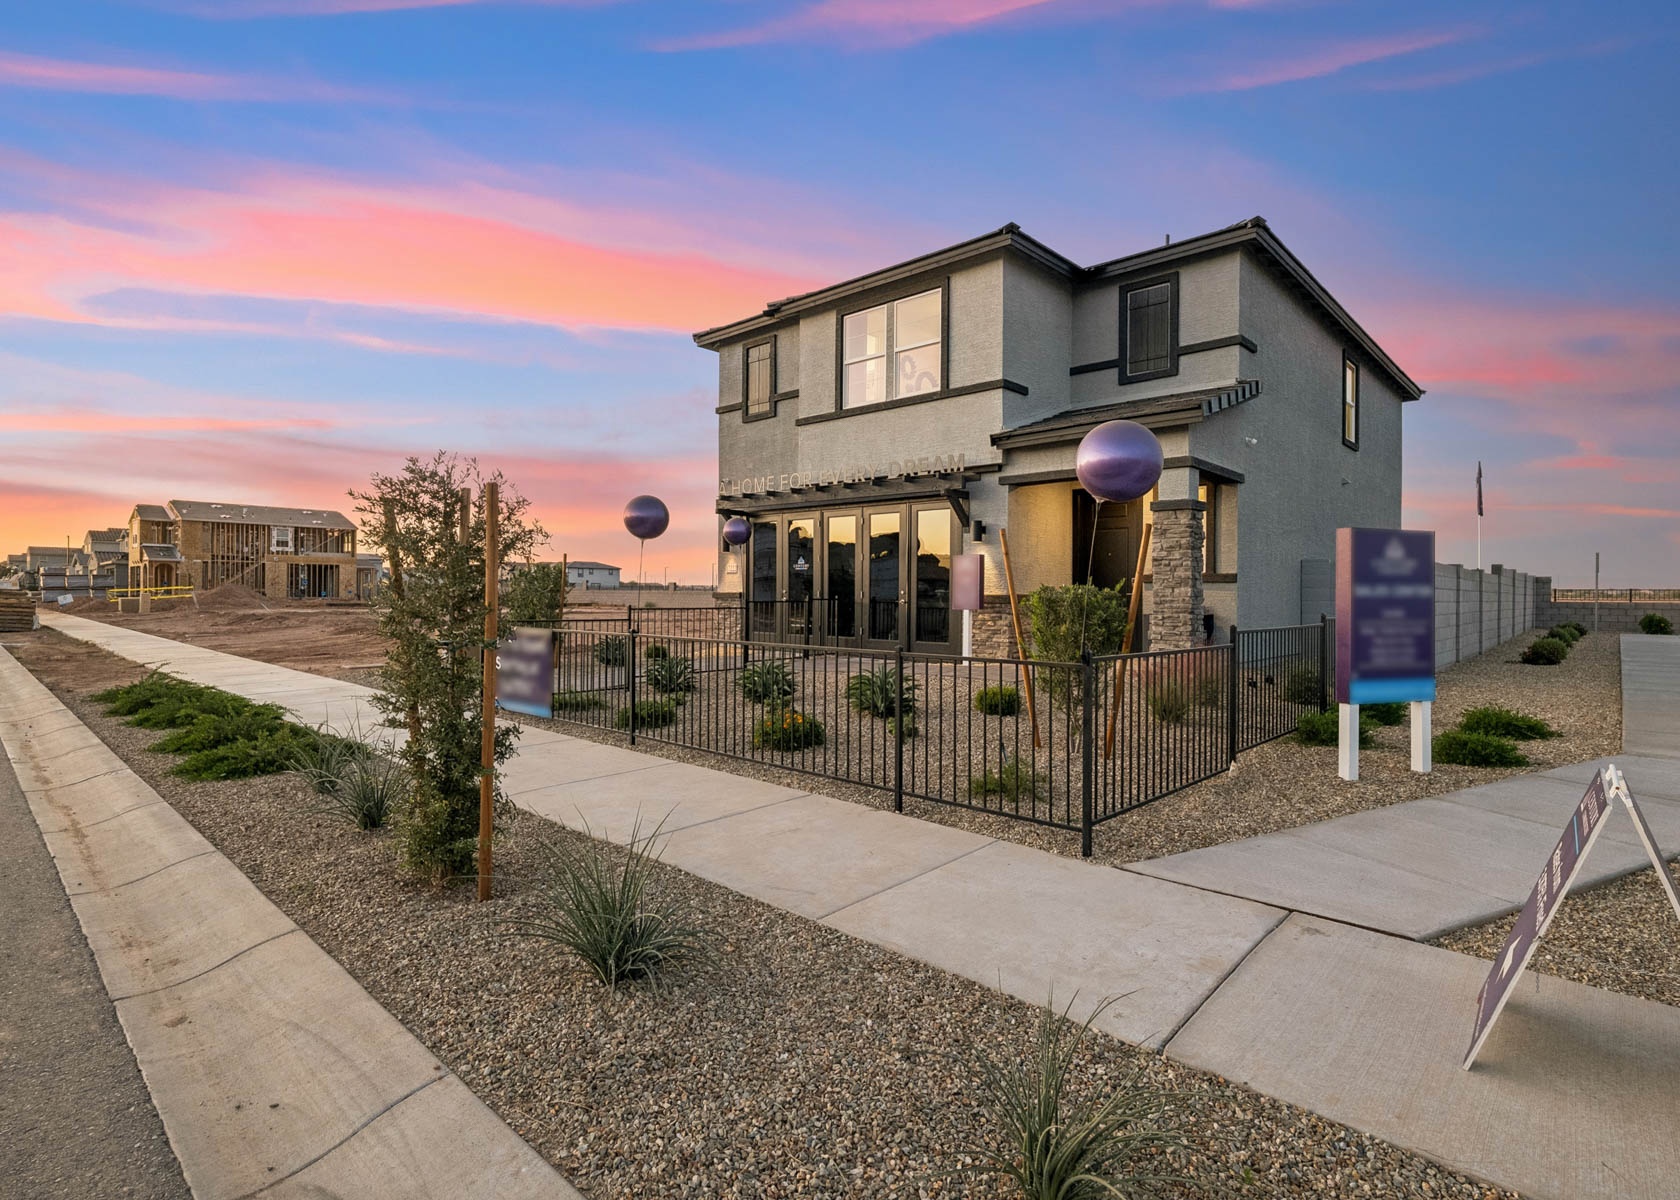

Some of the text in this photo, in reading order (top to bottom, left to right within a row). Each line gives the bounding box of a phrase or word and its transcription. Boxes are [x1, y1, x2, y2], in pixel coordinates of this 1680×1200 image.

[731, 475, 775, 495] HOME
[780, 472, 813, 491] FOR
[819, 463, 880, 486] EVERY
[887, 453, 965, 480] DREAM
